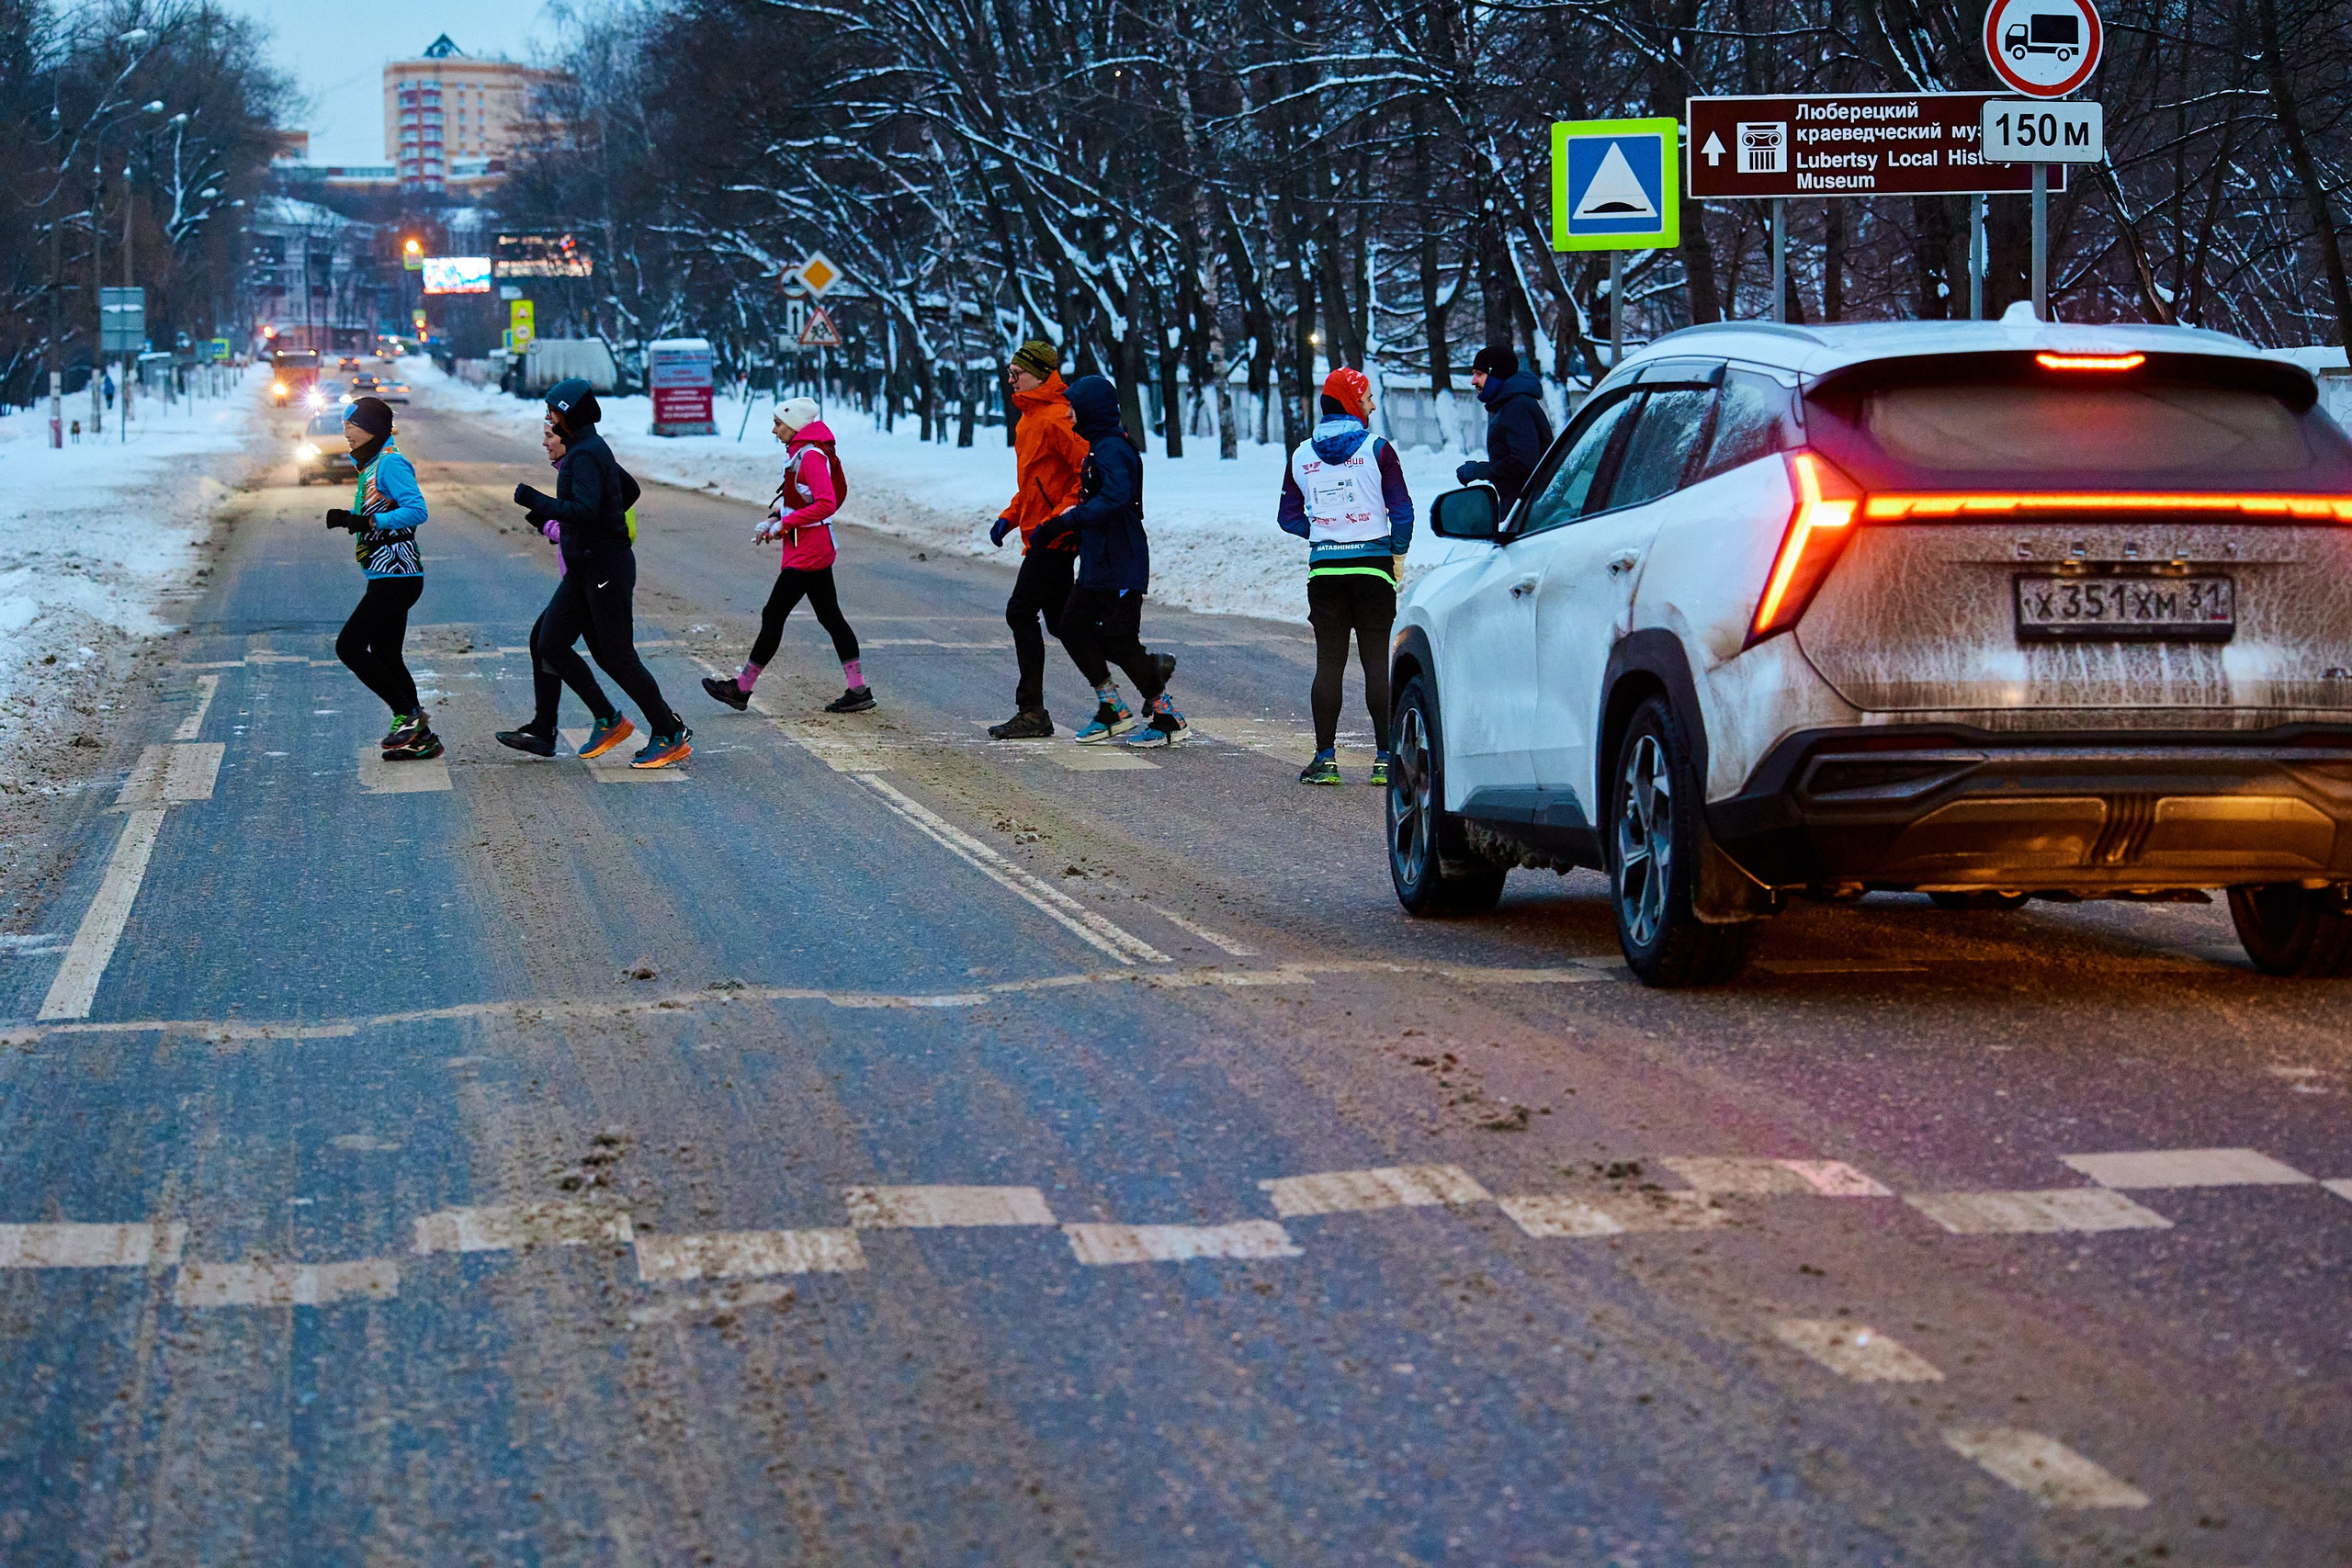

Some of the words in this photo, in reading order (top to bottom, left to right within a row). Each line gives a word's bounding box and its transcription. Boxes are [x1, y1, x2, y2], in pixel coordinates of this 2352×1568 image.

[1795, 101, 1919, 123] Люберецкий
[1796, 121, 1941, 145] краеведческий
[1996, 112, 2057, 147] 150
[1796, 152, 1878, 172] Lubertsy
[1888, 149, 1939, 167] Local
[1796, 173, 1875, 189] Museum
